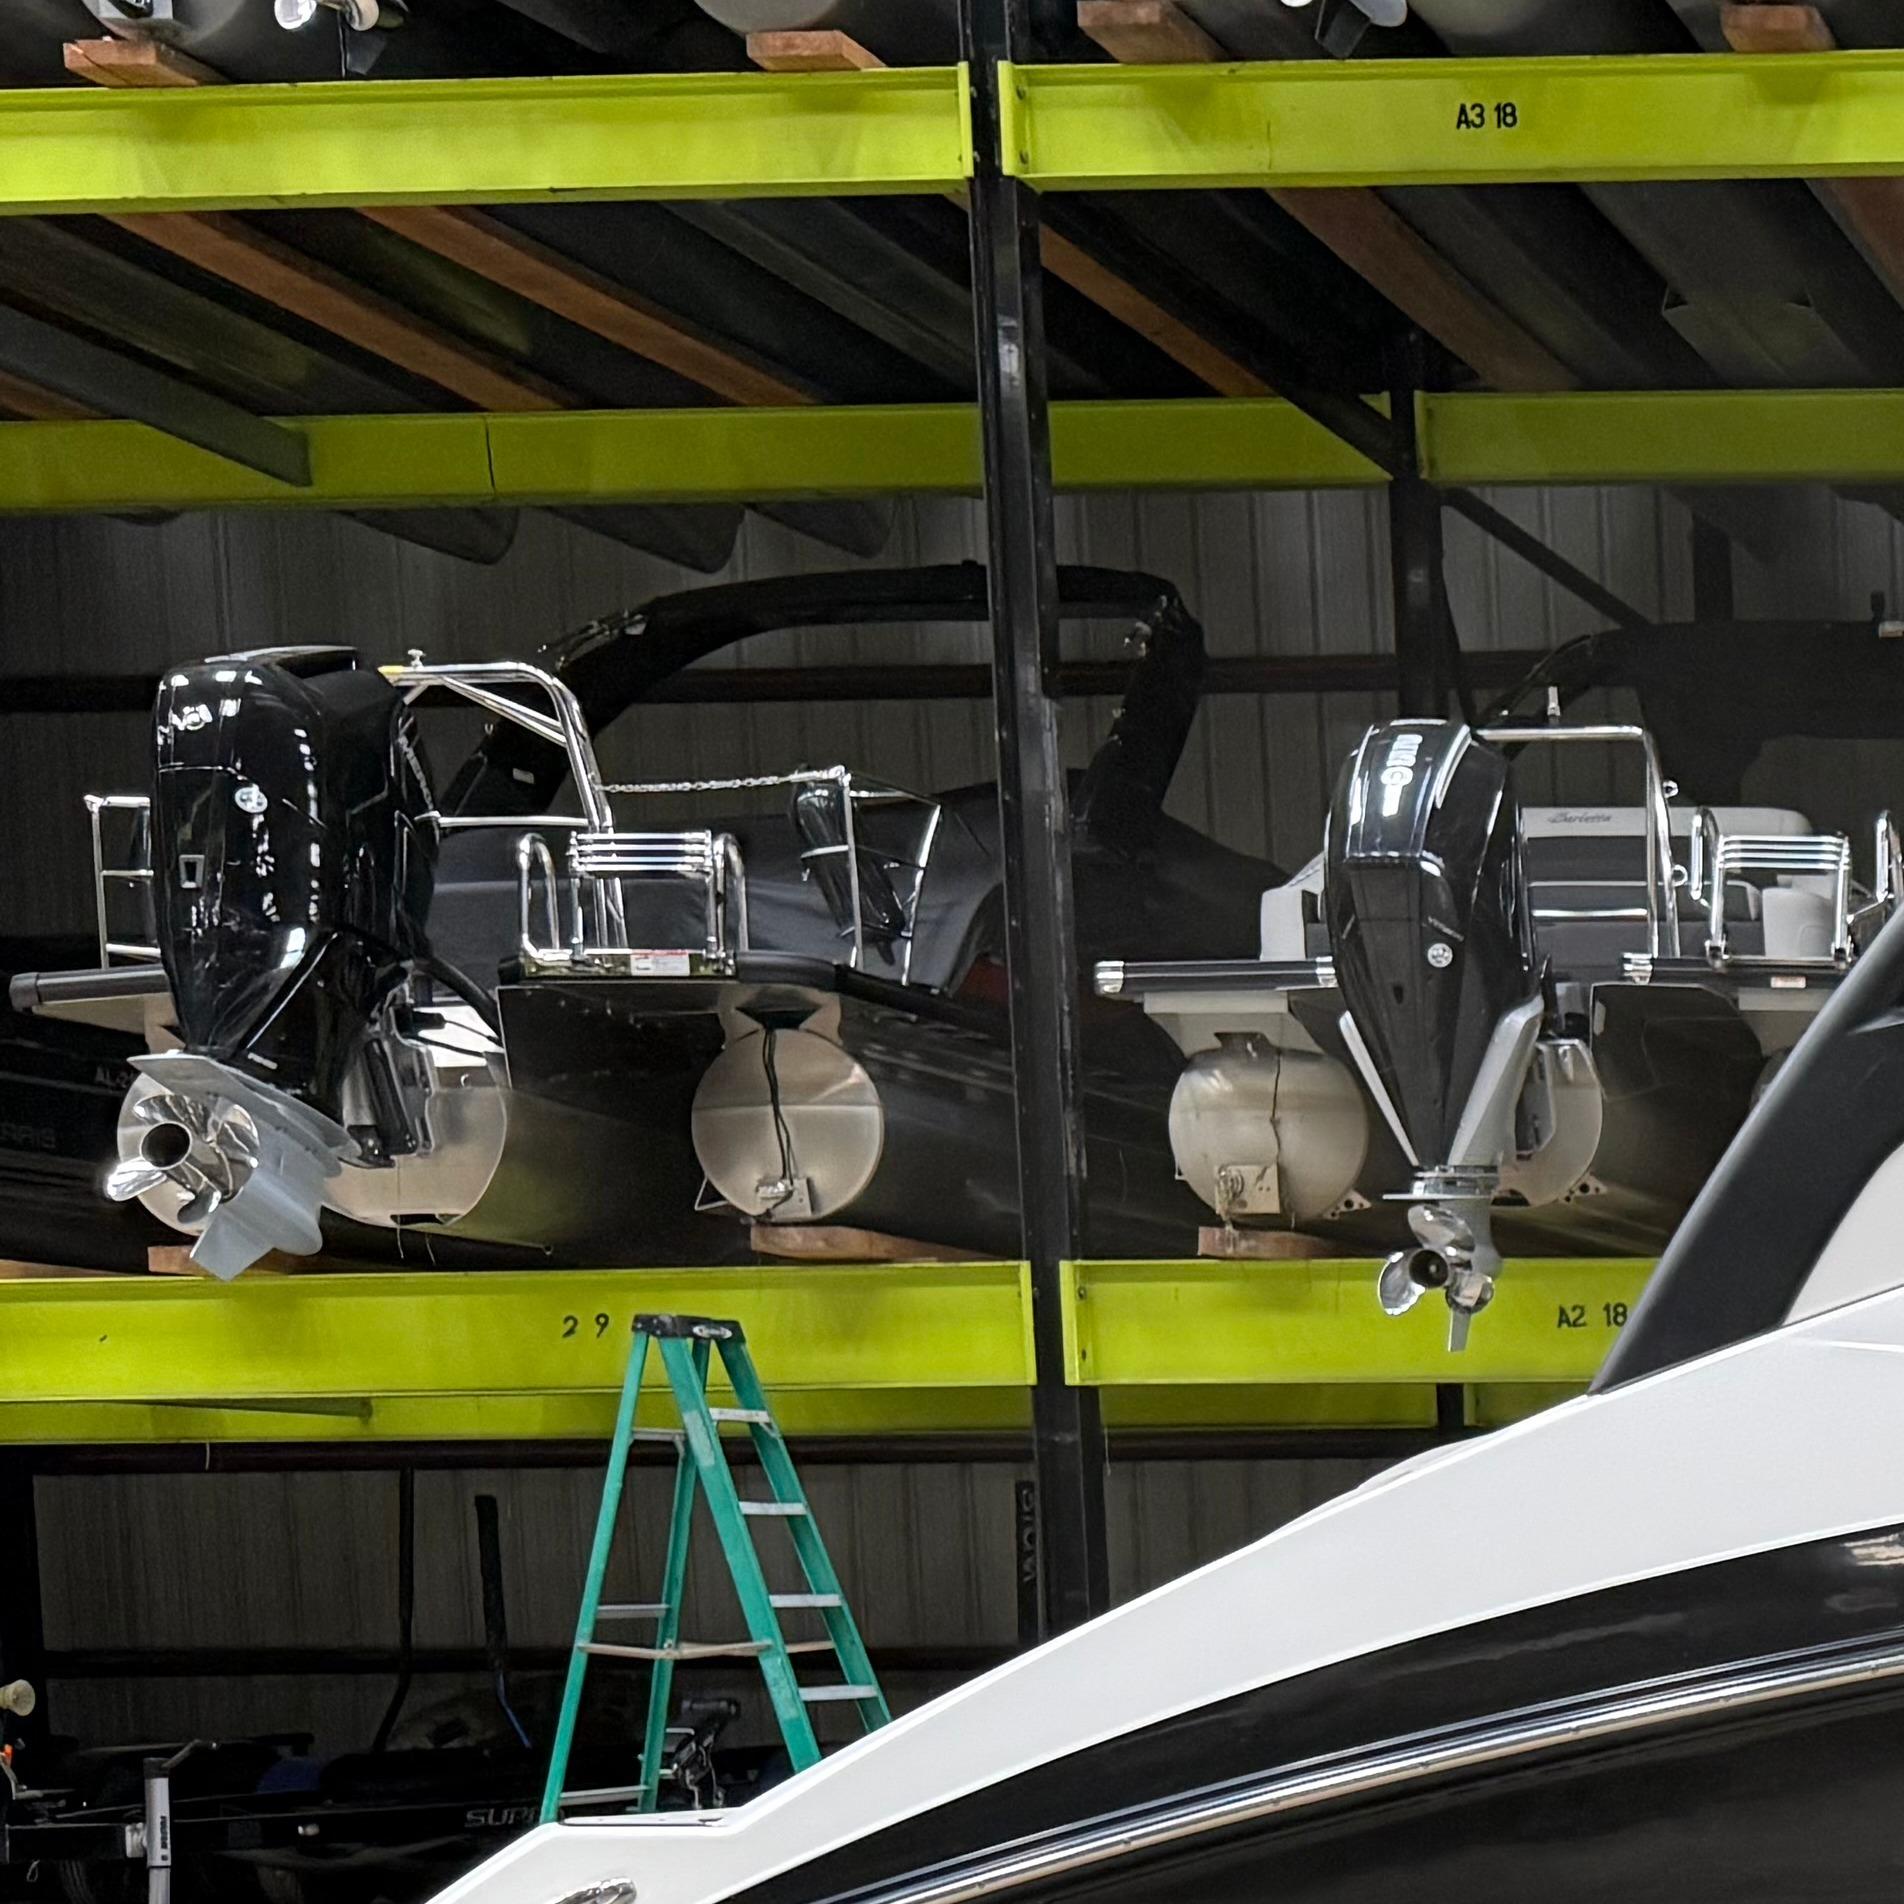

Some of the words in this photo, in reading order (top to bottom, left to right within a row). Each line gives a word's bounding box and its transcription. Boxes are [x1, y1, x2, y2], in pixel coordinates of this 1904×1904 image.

[1456, 102, 1485, 130] A3
[1494, 102, 1518, 130] 18
[1557, 1303, 1587, 1328] A2
[1603, 1302, 1628, 1328] 18
